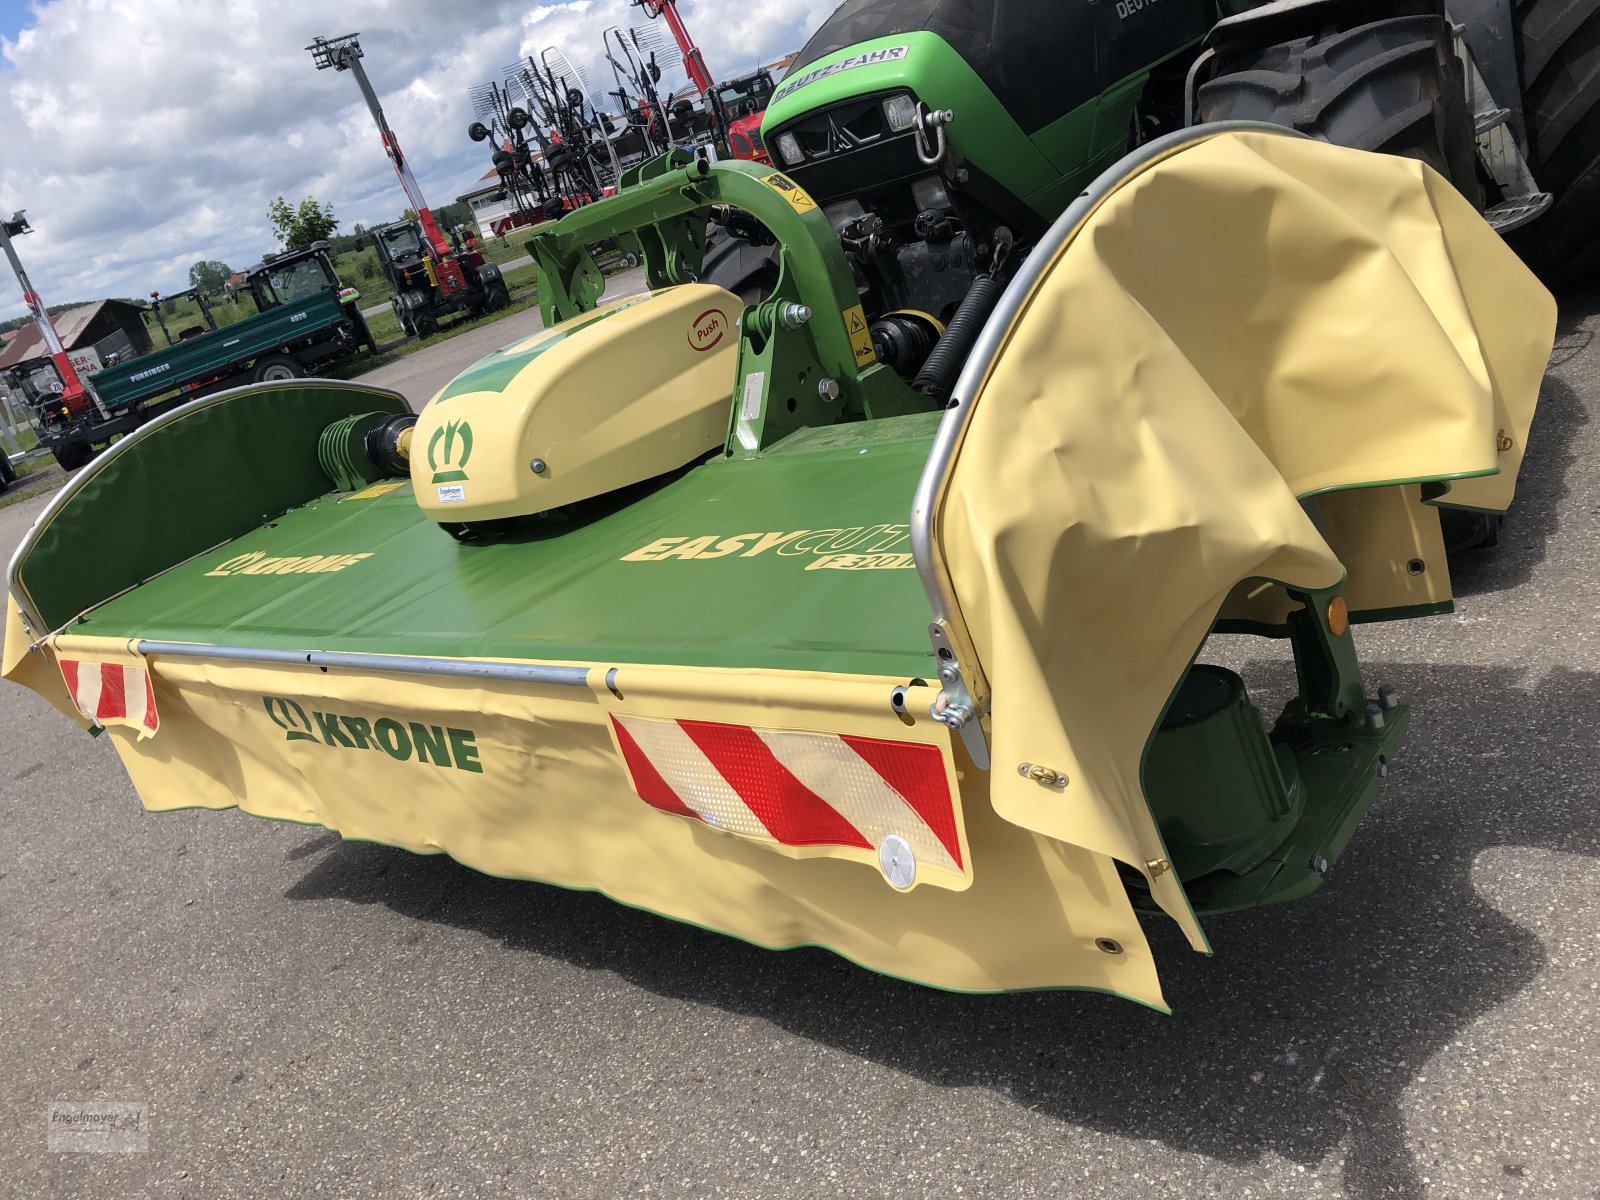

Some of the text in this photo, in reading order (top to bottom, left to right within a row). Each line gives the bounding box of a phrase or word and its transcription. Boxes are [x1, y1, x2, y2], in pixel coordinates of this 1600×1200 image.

[1116, 0, 1157, 19] DEU
[774, 47, 904, 101] DEUTZ-FAHR
[697, 318, 719, 342] Push
[52, 383, 61, 392] 20
[619, 524, 910, 561] EASYCUT
[232, 553, 376, 576] KRONE
[312, 711, 484, 774] KRONE
